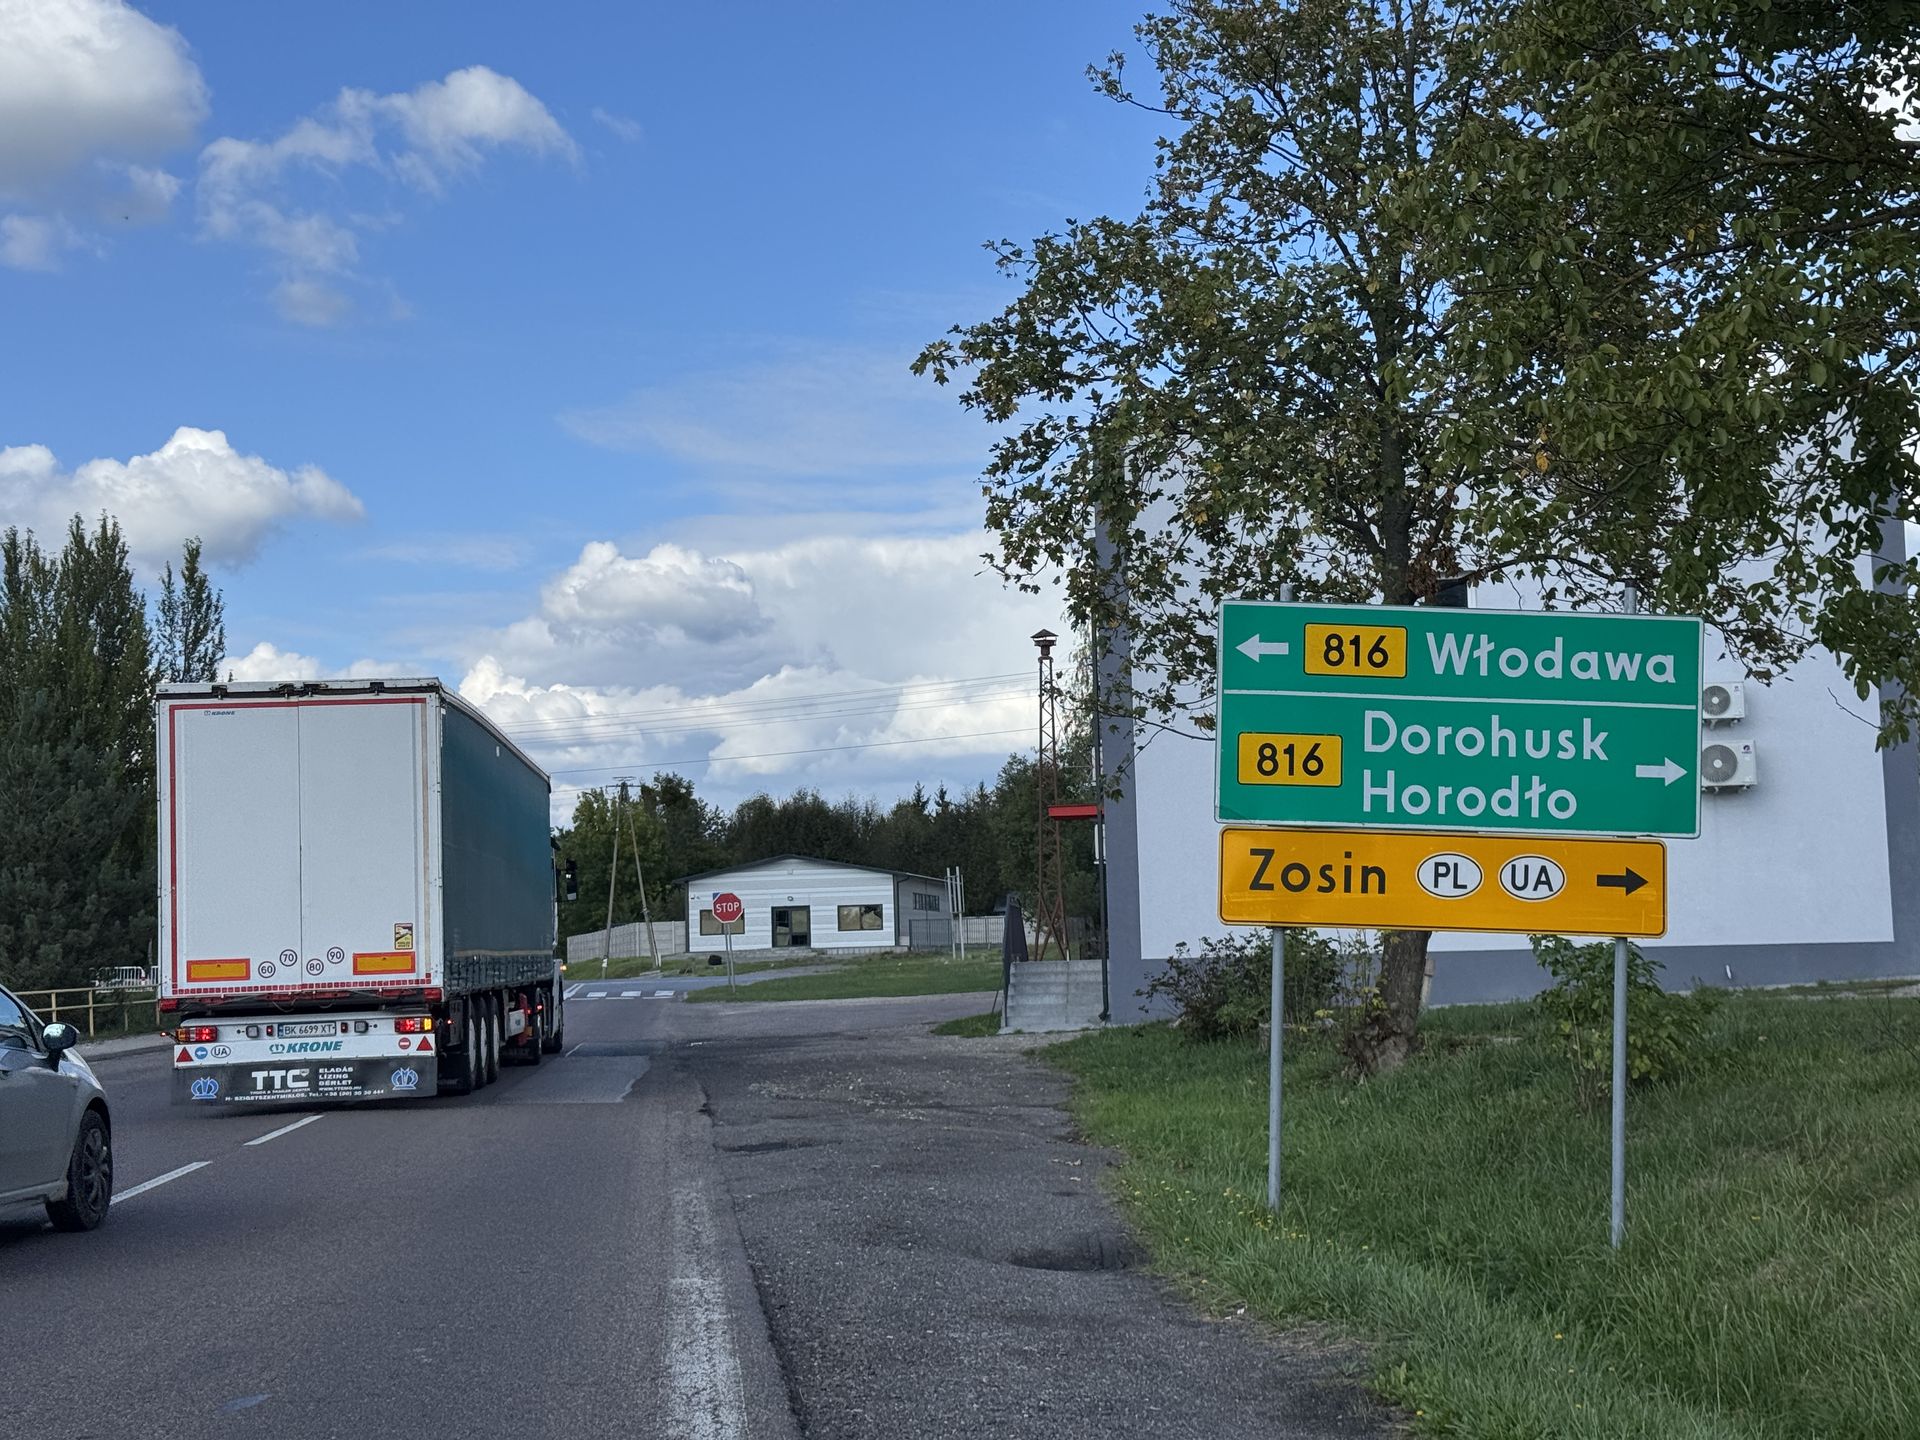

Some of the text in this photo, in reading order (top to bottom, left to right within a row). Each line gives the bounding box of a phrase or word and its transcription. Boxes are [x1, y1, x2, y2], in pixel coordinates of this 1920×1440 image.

[1323, 633, 1389, 669] 816
[1426, 632, 1676, 683] Włodawa
[1363, 710, 1609, 761] Dorohusk
[1256, 742, 1324, 777] 816
[1362, 769, 1577, 820] Horodło
[1249, 848, 1386, 894] Zosin
[1433, 862, 1468, 890] PL
[1510, 864, 1554, 893] UA
[716, 901, 740, 913] STOP
[283, 953, 294, 962] 70
[329, 951, 341, 960] 90
[261, 965, 273, 974] 60
[309, 962, 321, 971] 80
[284, 1024, 333, 1035] BK 6699 XT
[214, 1047, 227, 1056] UA
[286, 1041, 343, 1053] KRONE
[251, 1069, 309, 1090] TTC
